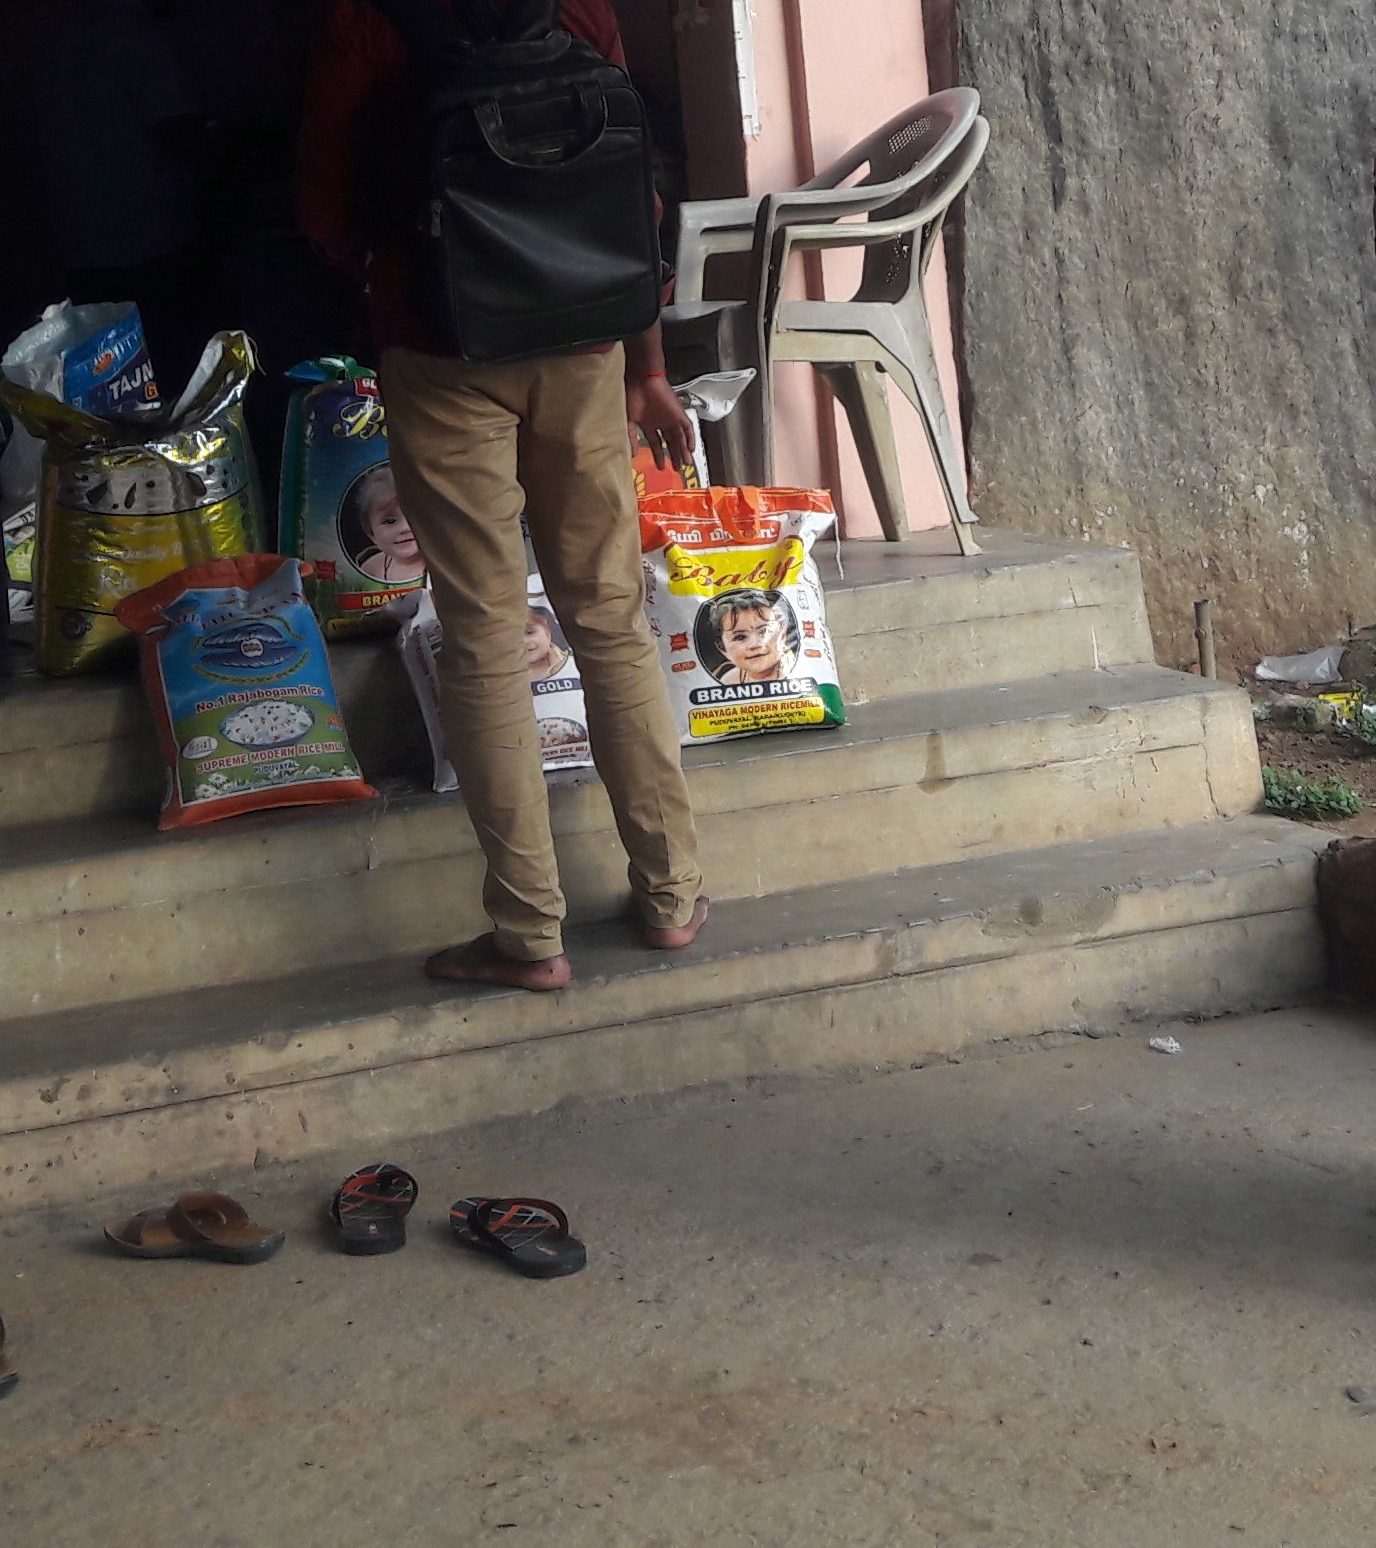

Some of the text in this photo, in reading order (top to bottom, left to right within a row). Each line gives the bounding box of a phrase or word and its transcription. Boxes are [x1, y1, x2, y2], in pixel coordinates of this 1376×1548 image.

[670, 556, 804, 590] Baby
[535, 679, 574, 694] GOLD
[696, 682, 764, 703] BRAND
[298, 743, 321, 756] RICE
